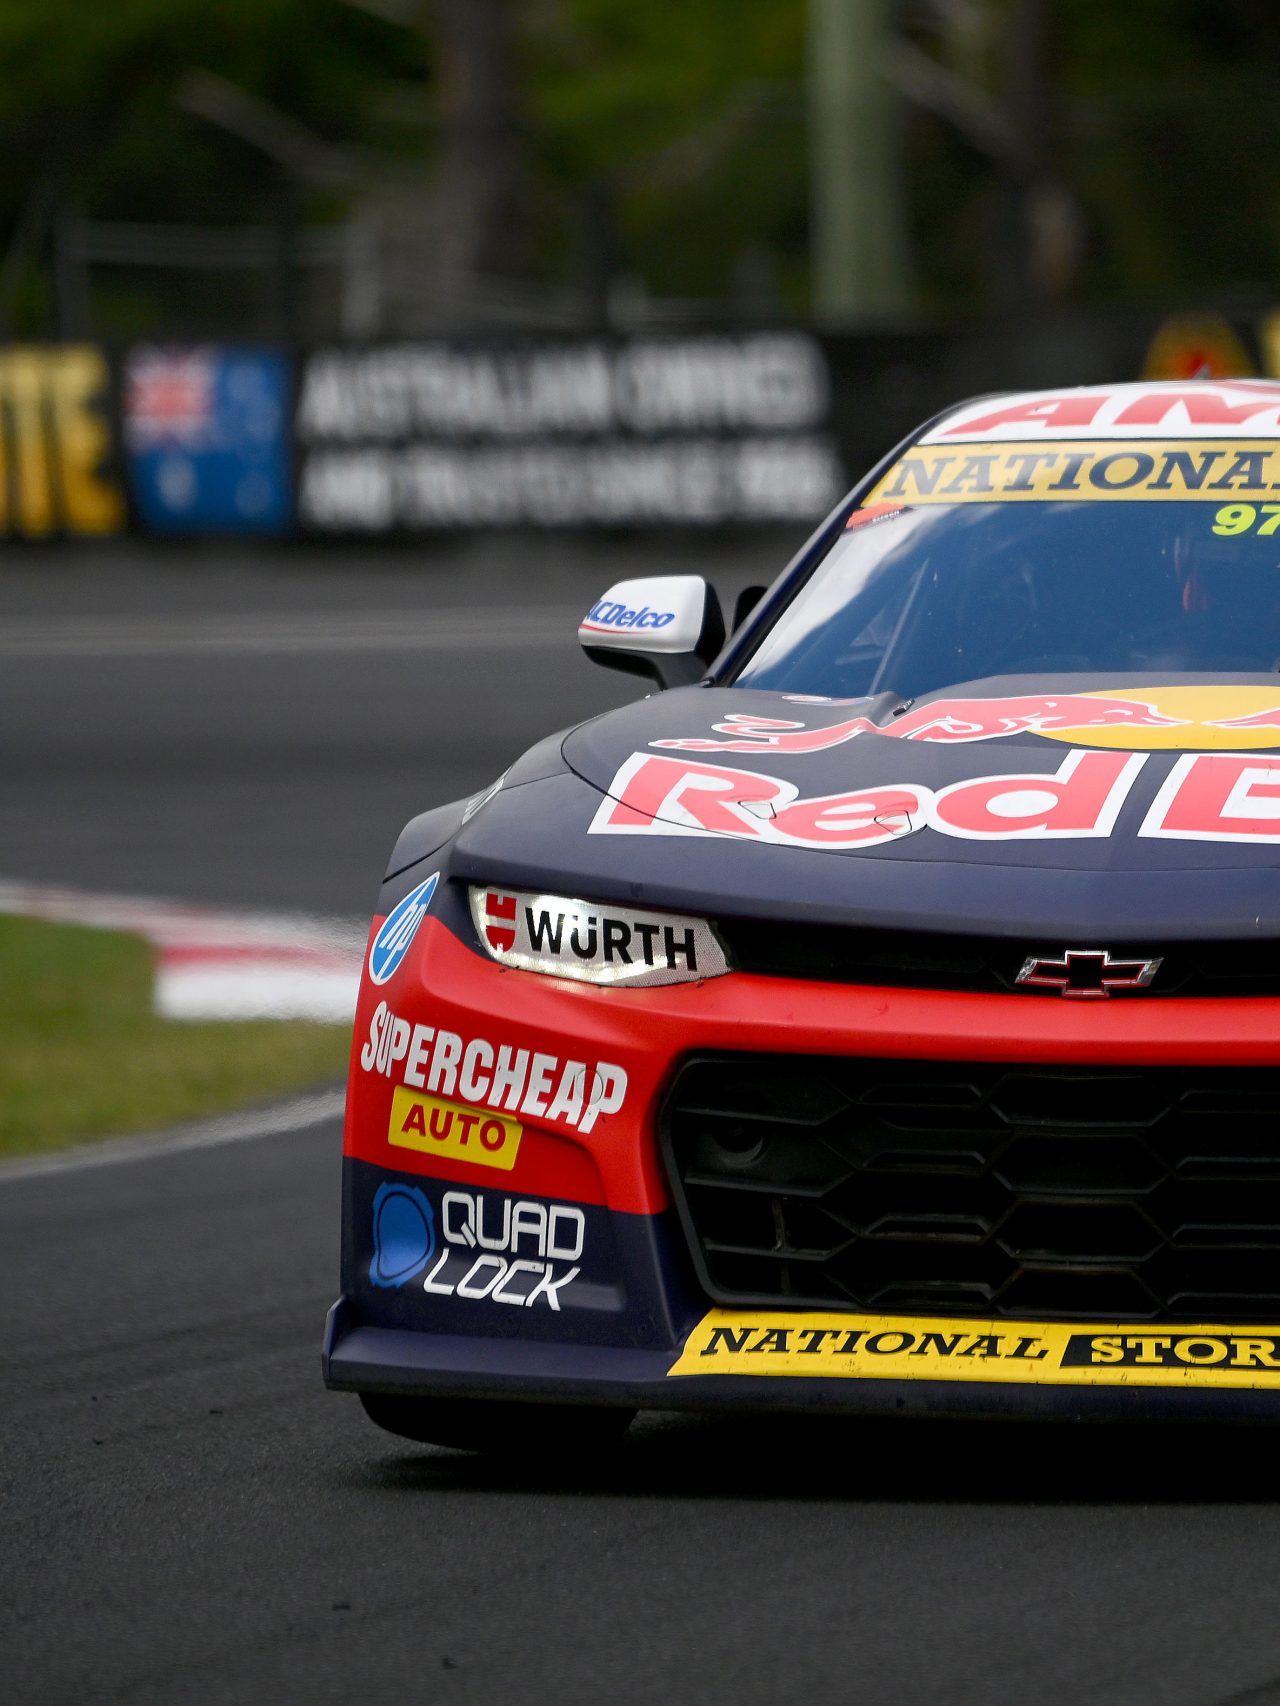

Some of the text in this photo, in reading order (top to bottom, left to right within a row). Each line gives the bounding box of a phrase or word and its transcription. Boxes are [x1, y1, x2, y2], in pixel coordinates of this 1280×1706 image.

[586, 749, 1151, 850] Red
[376, 878, 428, 980] hp
[361, 1001, 629, 1136] SUPERCHEAP
[402, 1103, 507, 1152] AUTO
[442, 1192, 585, 1262] QUAD
[423, 1249, 581, 1312] LOCK
[701, 1326, 1053, 1359] NATIONAL
